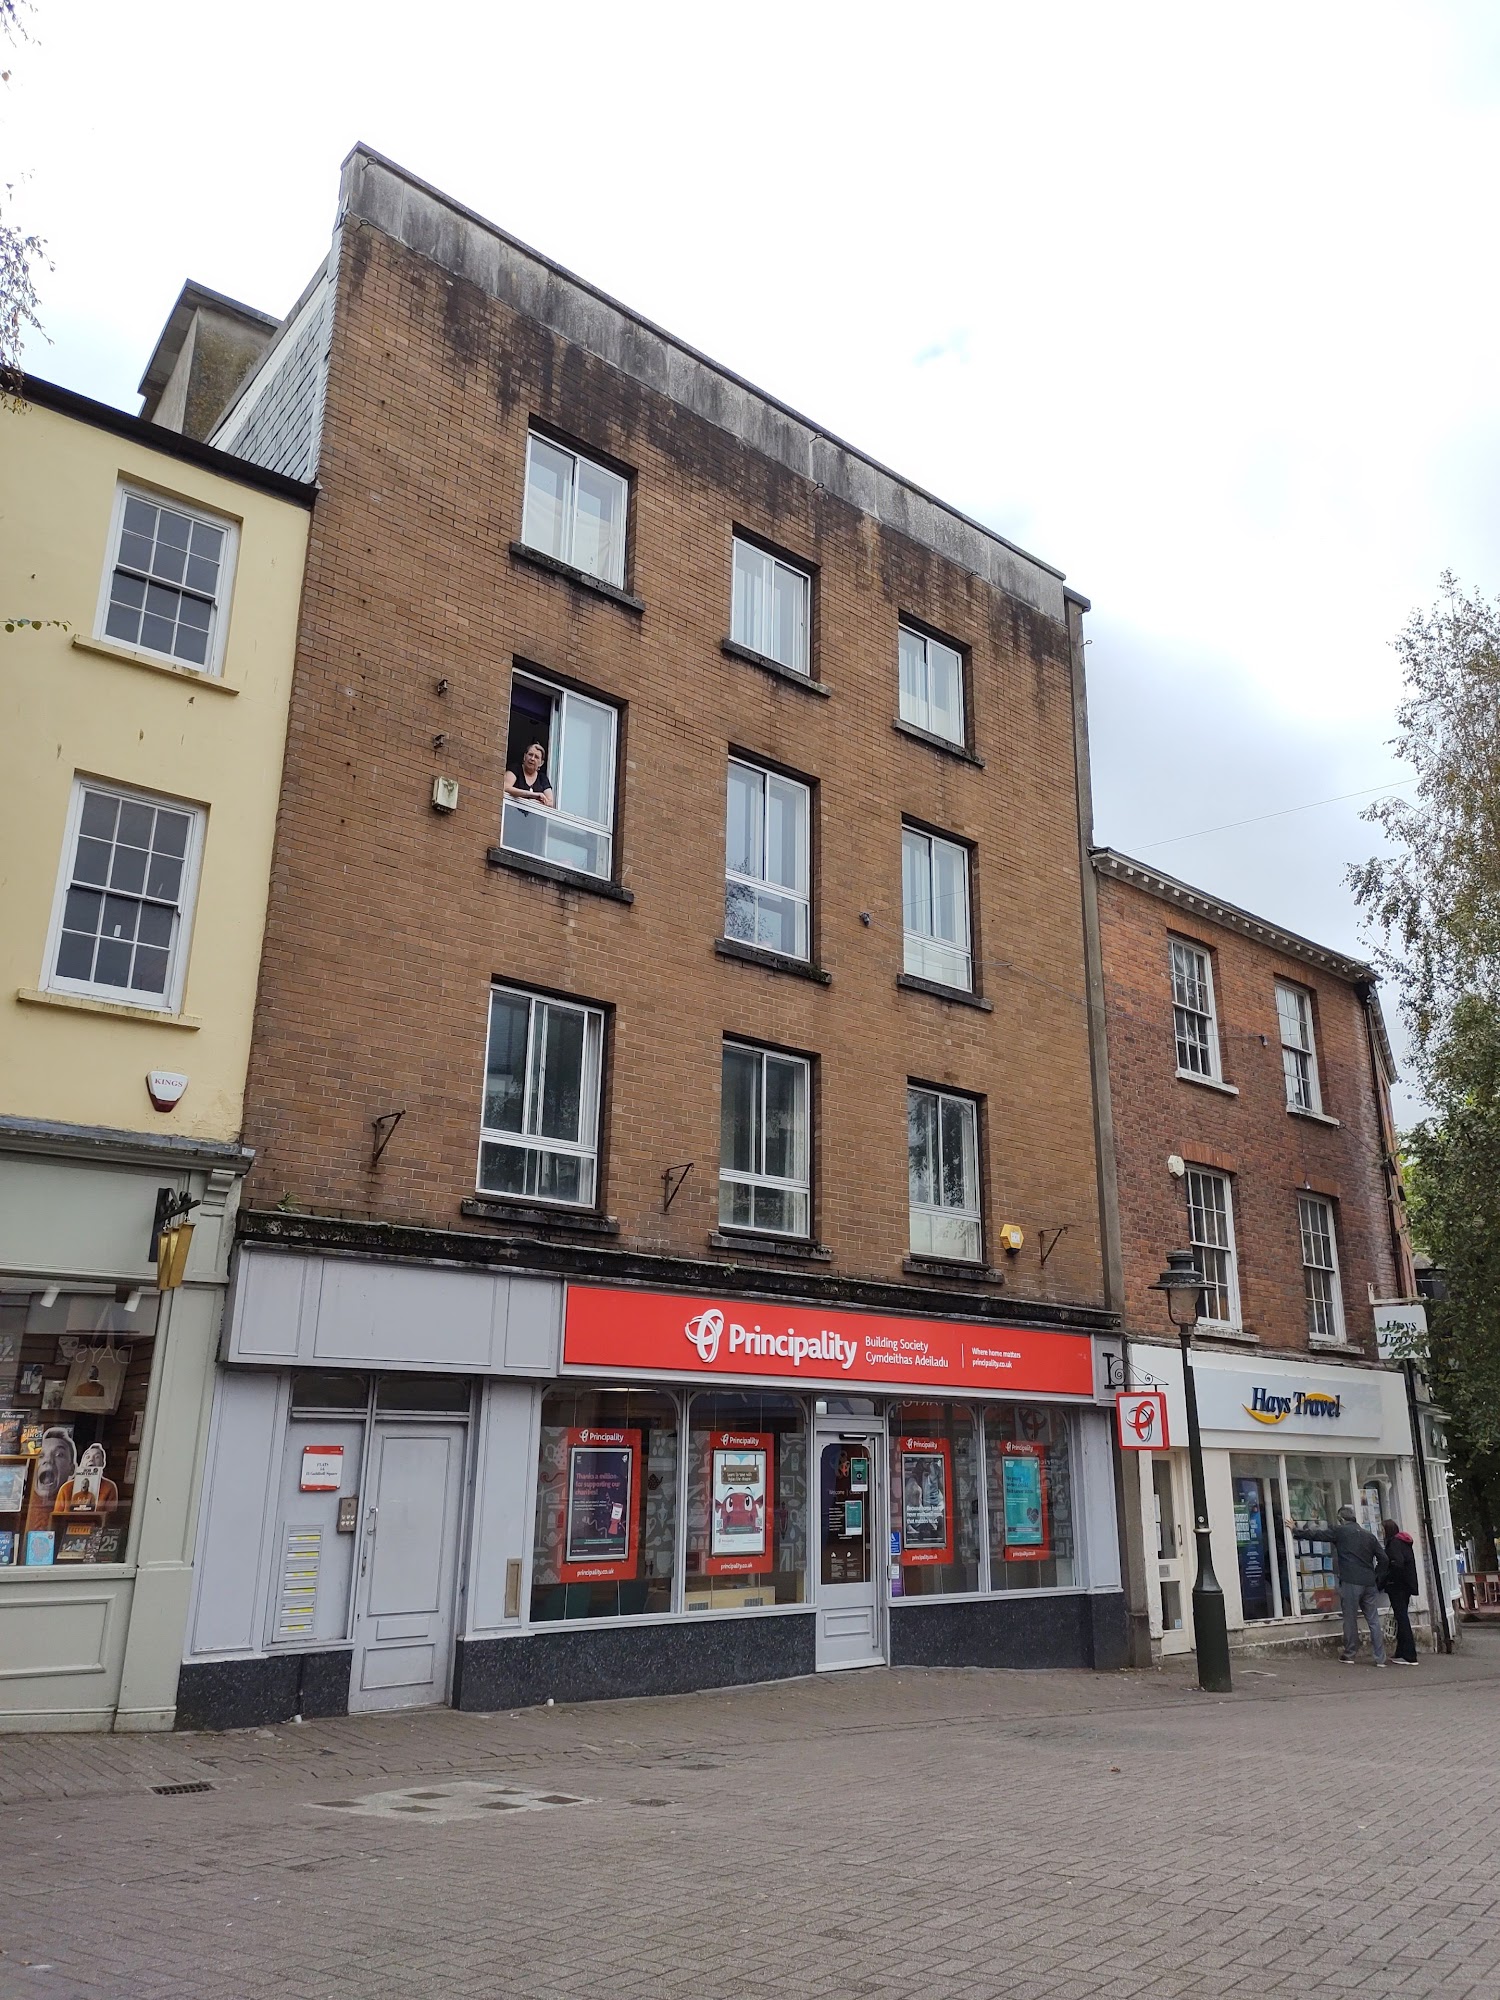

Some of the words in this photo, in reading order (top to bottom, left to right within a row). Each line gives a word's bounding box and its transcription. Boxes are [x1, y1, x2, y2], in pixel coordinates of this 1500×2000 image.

[155, 1078, 183, 1087] KINGS
[865, 1336, 898, 1351] Building
[900, 1339, 928, 1353] Society
[1382, 1333, 1417, 1345] Trave
[729, 1323, 858, 1370] Principality
[971, 1347, 988, 1356] Where
[988, 1348, 1002, 1357] home
[1003, 1350, 1021, 1359] matters
[865, 1352, 913, 1366] Cymdeithas
[915, 1355, 949, 1368] Adeiladu
[972, 1358, 1013, 1369] principality.co.uk
[1251, 1387, 1291, 1419] Hays
[1293, 1391, 1341, 1418] Travel
[589, 1432, 624, 1443] Principality
[729, 1436, 759, 1446] Principality
[913, 1440, 937, 1449] Principality
[1012, 1444, 1033, 1453] Principality
[99, 1536, 119, 1551] 25
[721, 1562, 753, 1570] principality.co.uk
[576, 1568, 614, 1576] principality.co.uk
